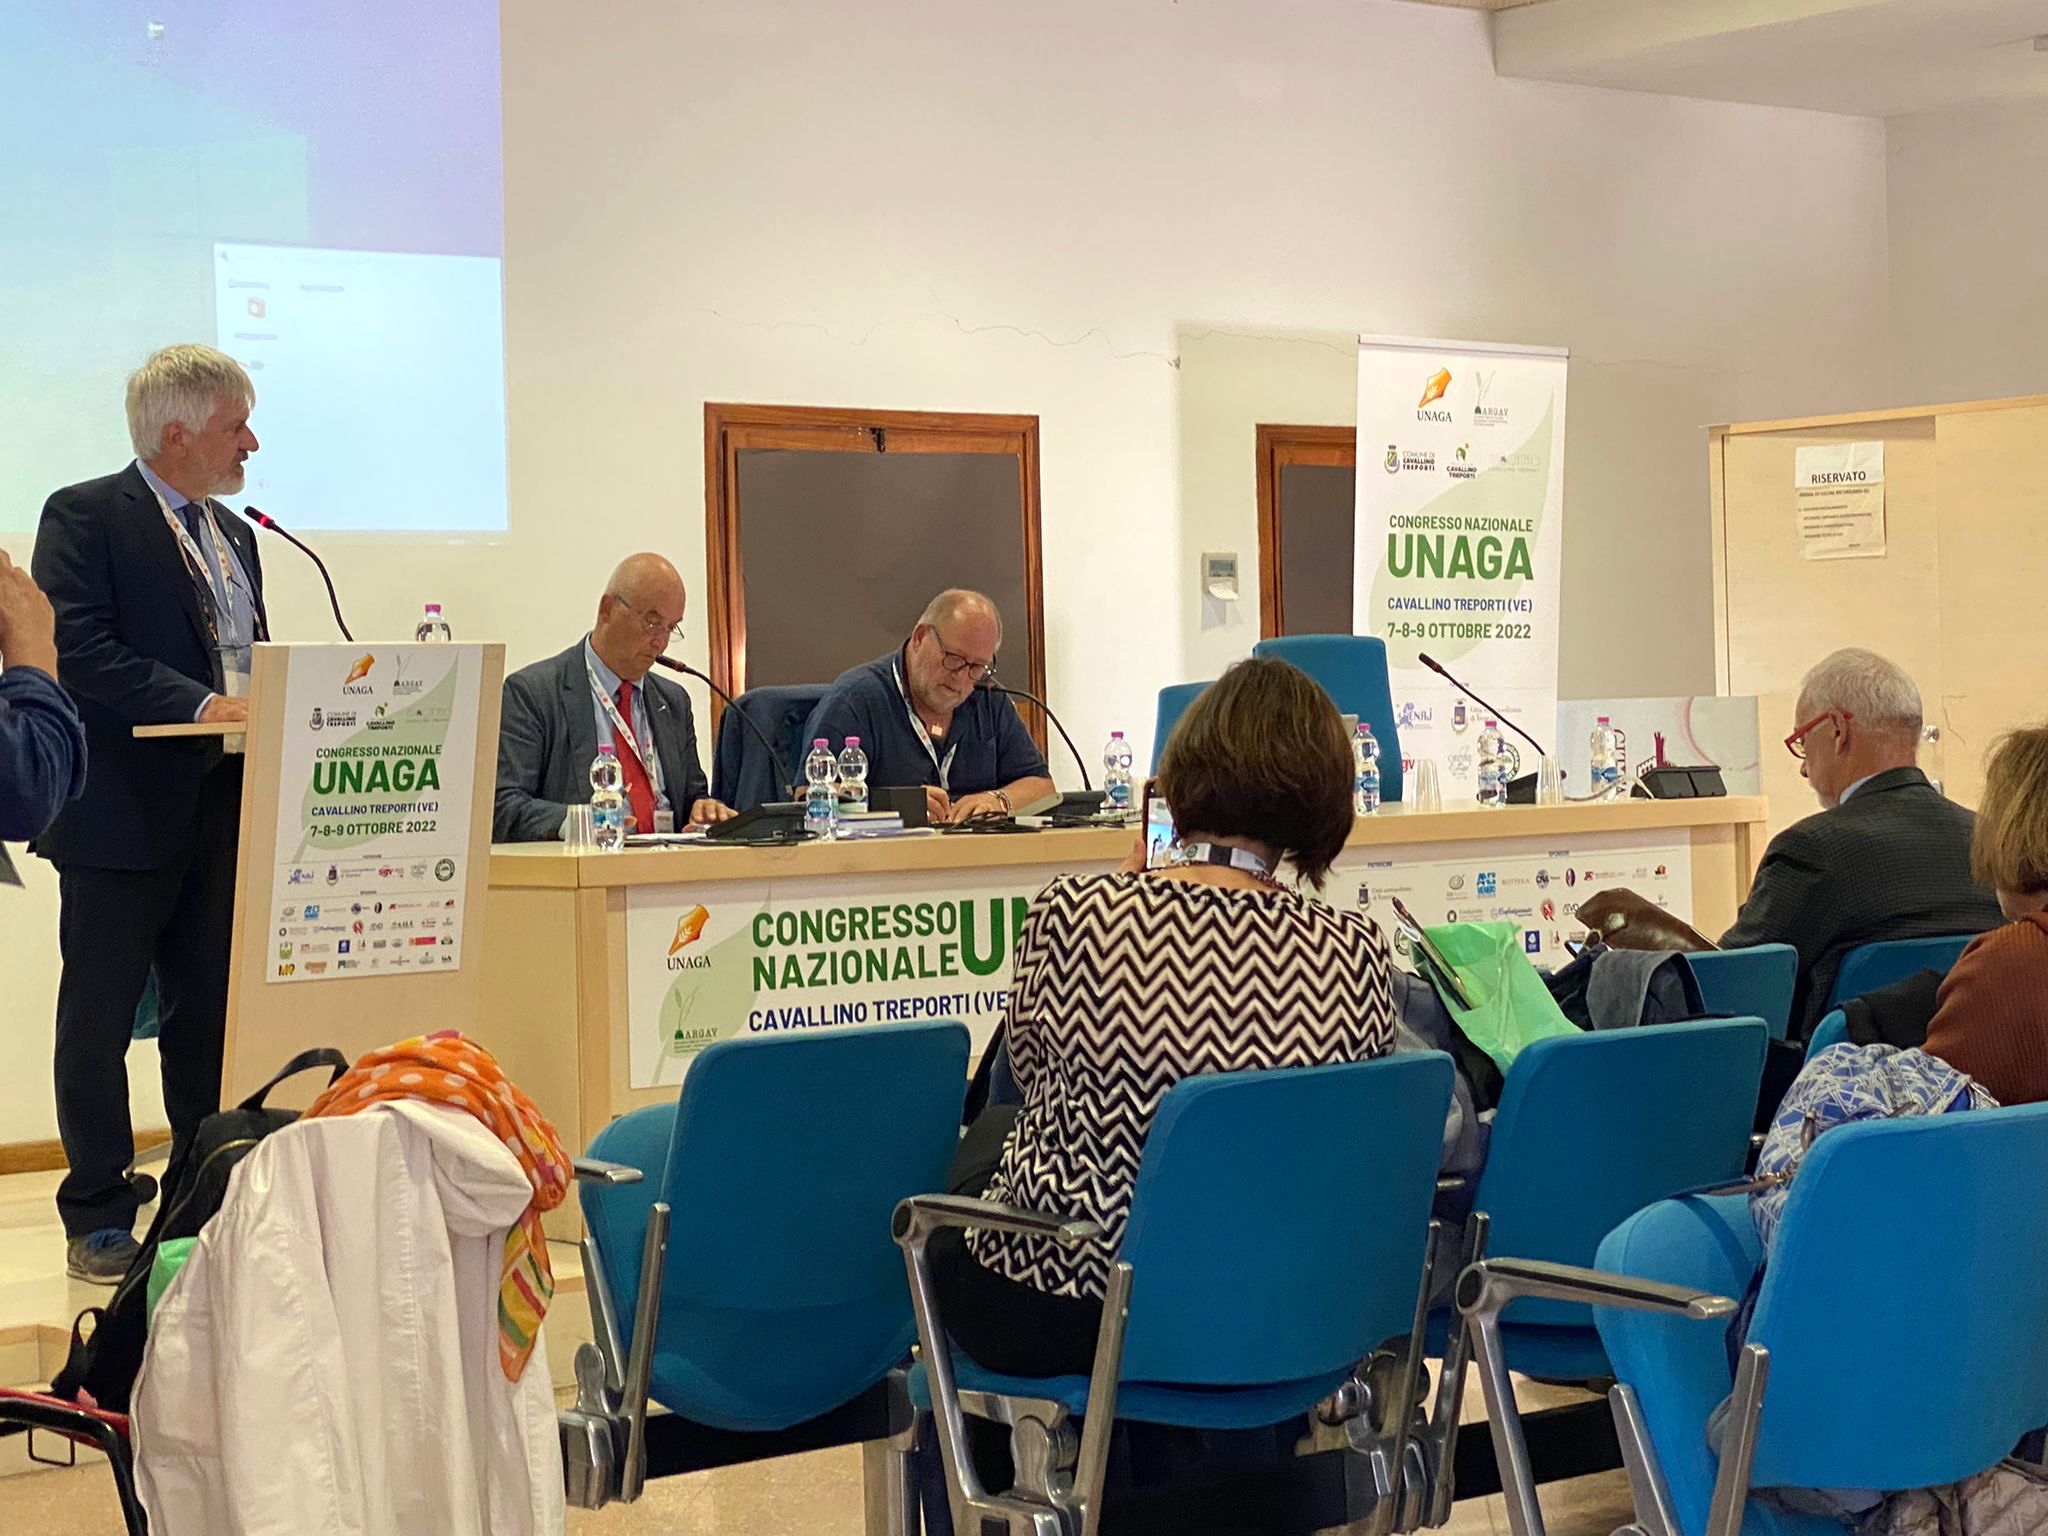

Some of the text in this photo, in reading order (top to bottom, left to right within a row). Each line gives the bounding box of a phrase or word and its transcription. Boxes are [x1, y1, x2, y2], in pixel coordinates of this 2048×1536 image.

[1417, 410, 1452, 423] UNAGA
[1402, 450, 1428, 458] COMUNE
[1811, 470, 1867, 485] RISERVATO
[1389, 514, 1534, 532] CONGRESSO NAZIONALE
[1387, 533, 1534, 581] UNAGA
[1387, 596, 1533, 613] CAVALLINO TREPORTI (VE)
[1387, 622, 1531, 639] 7-8-9 OTTOBRE 2022
[342, 686, 374, 696] UNAGA
[315, 744, 442, 759] CONGRESSO NAZIONALE
[312, 758, 441, 795] UNAGA
[311, 801, 439, 817] CAVALLINO TREPORTI (VE)
[310, 820, 437, 838] 7-8-9 OTTOBRE 2022
[752, 900, 957, 948] CONGRESSO
[666, 955, 712, 971] UNAGA
[752, 941, 960, 992] NAZIONALE
[748, 1001, 868, 1033] CAVALLINO
[872, 992, 970, 1022] TREPORTI
[685, 1027, 718, 1039] ARGAV
